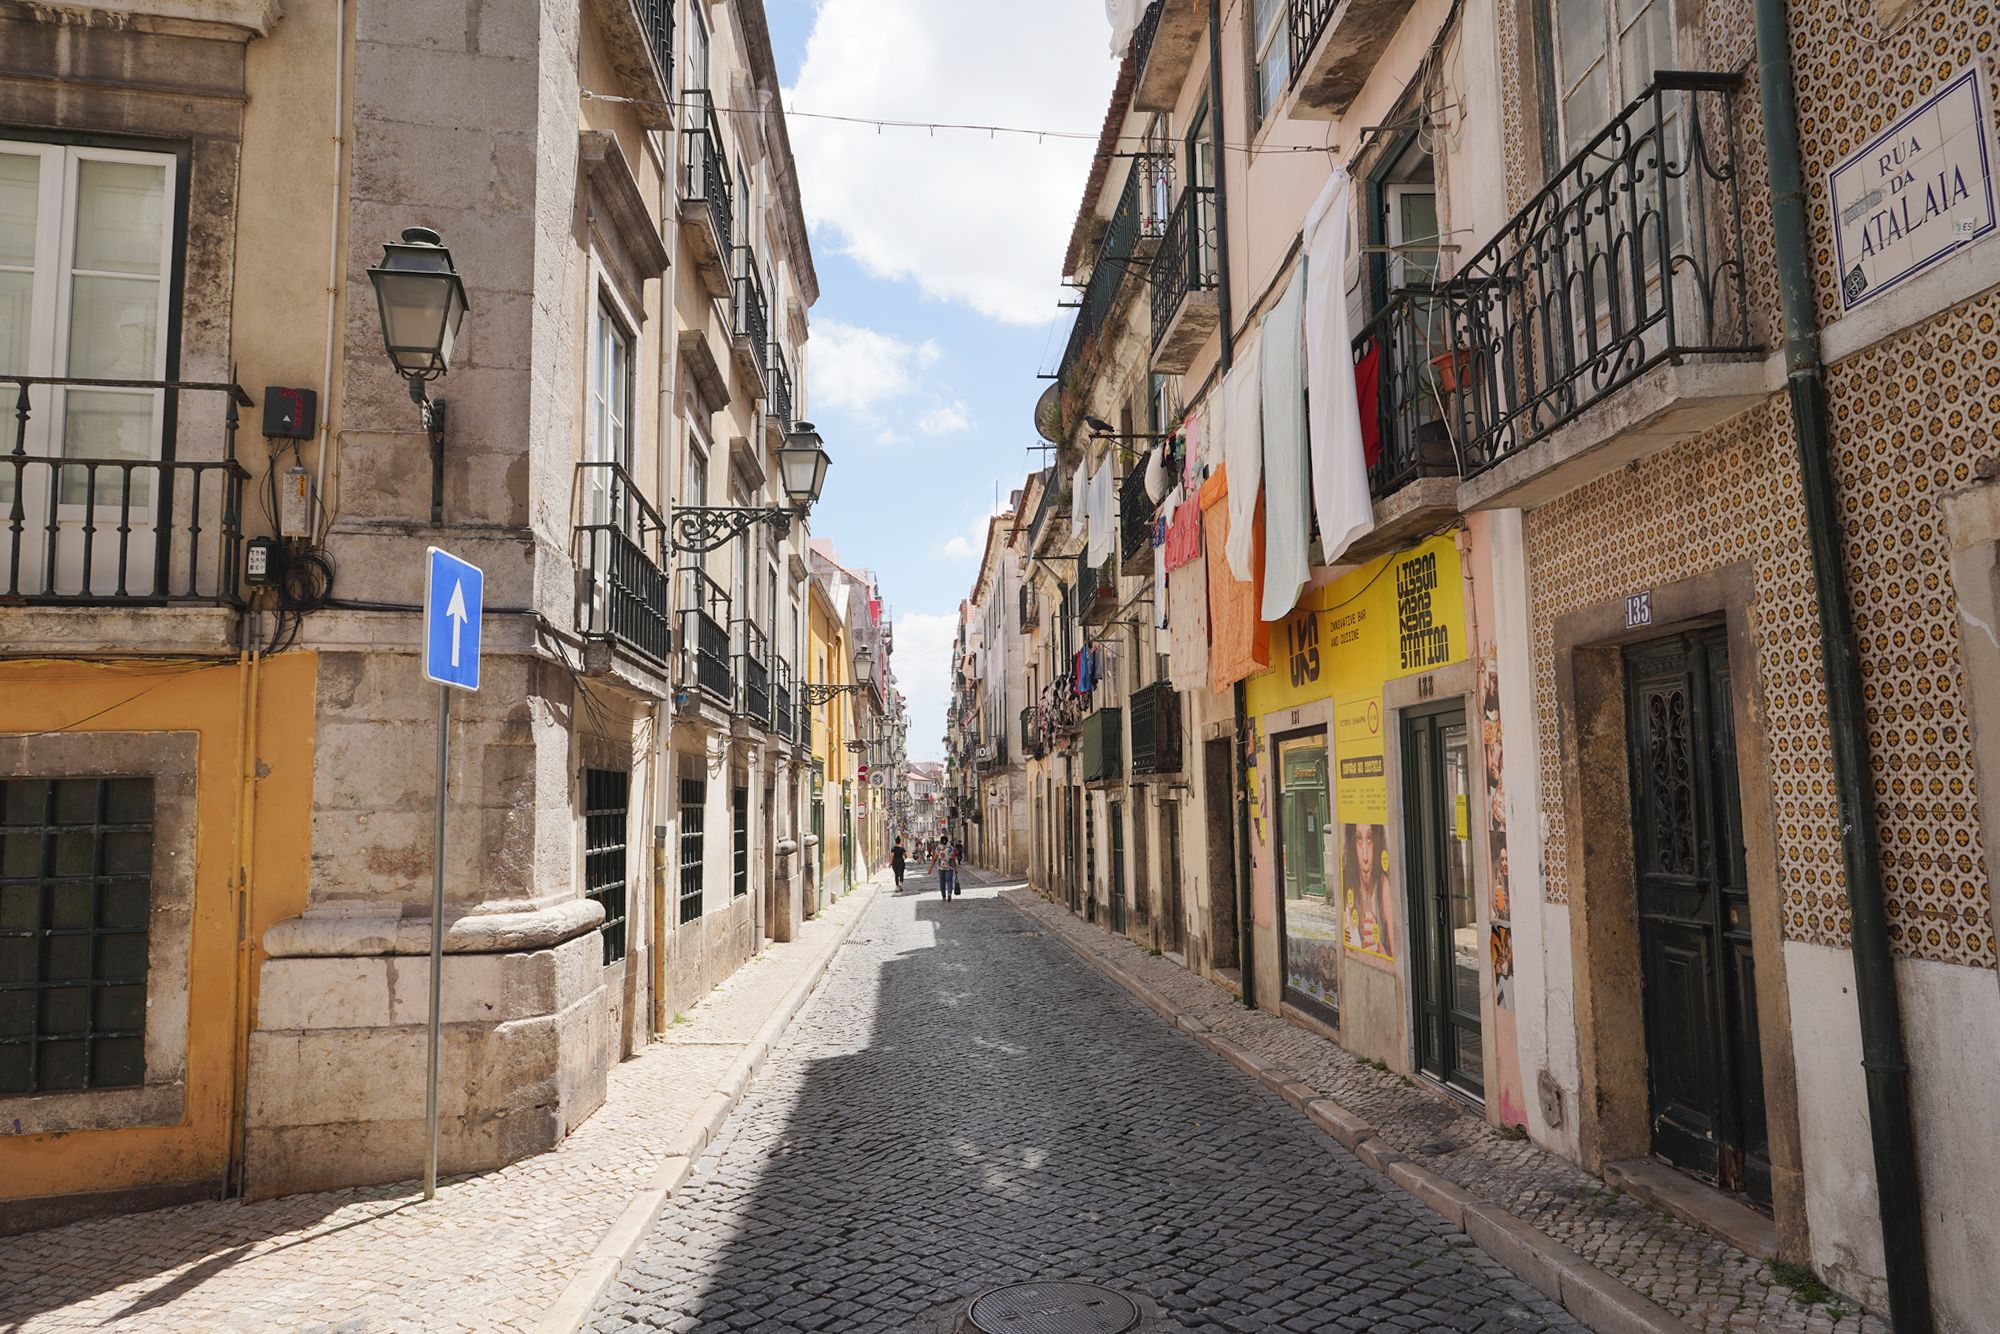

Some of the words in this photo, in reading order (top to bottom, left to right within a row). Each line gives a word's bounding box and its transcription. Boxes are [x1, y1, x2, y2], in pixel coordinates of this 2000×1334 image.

[1878, 136, 1922, 177] RUA
[1891, 169, 1916, 196] DA
[1861, 163, 1970, 262] ATALAIA
[1330, 613, 1356, 633] INNOVATIVE
[1357, 609, 1367, 622] BAR
[1627, 595, 1650, 626] 135
[1340, 628, 1360, 644] CUISINE
[1400, 624, 1450, 670] STATION
[1418, 676, 1434, 697] 133
